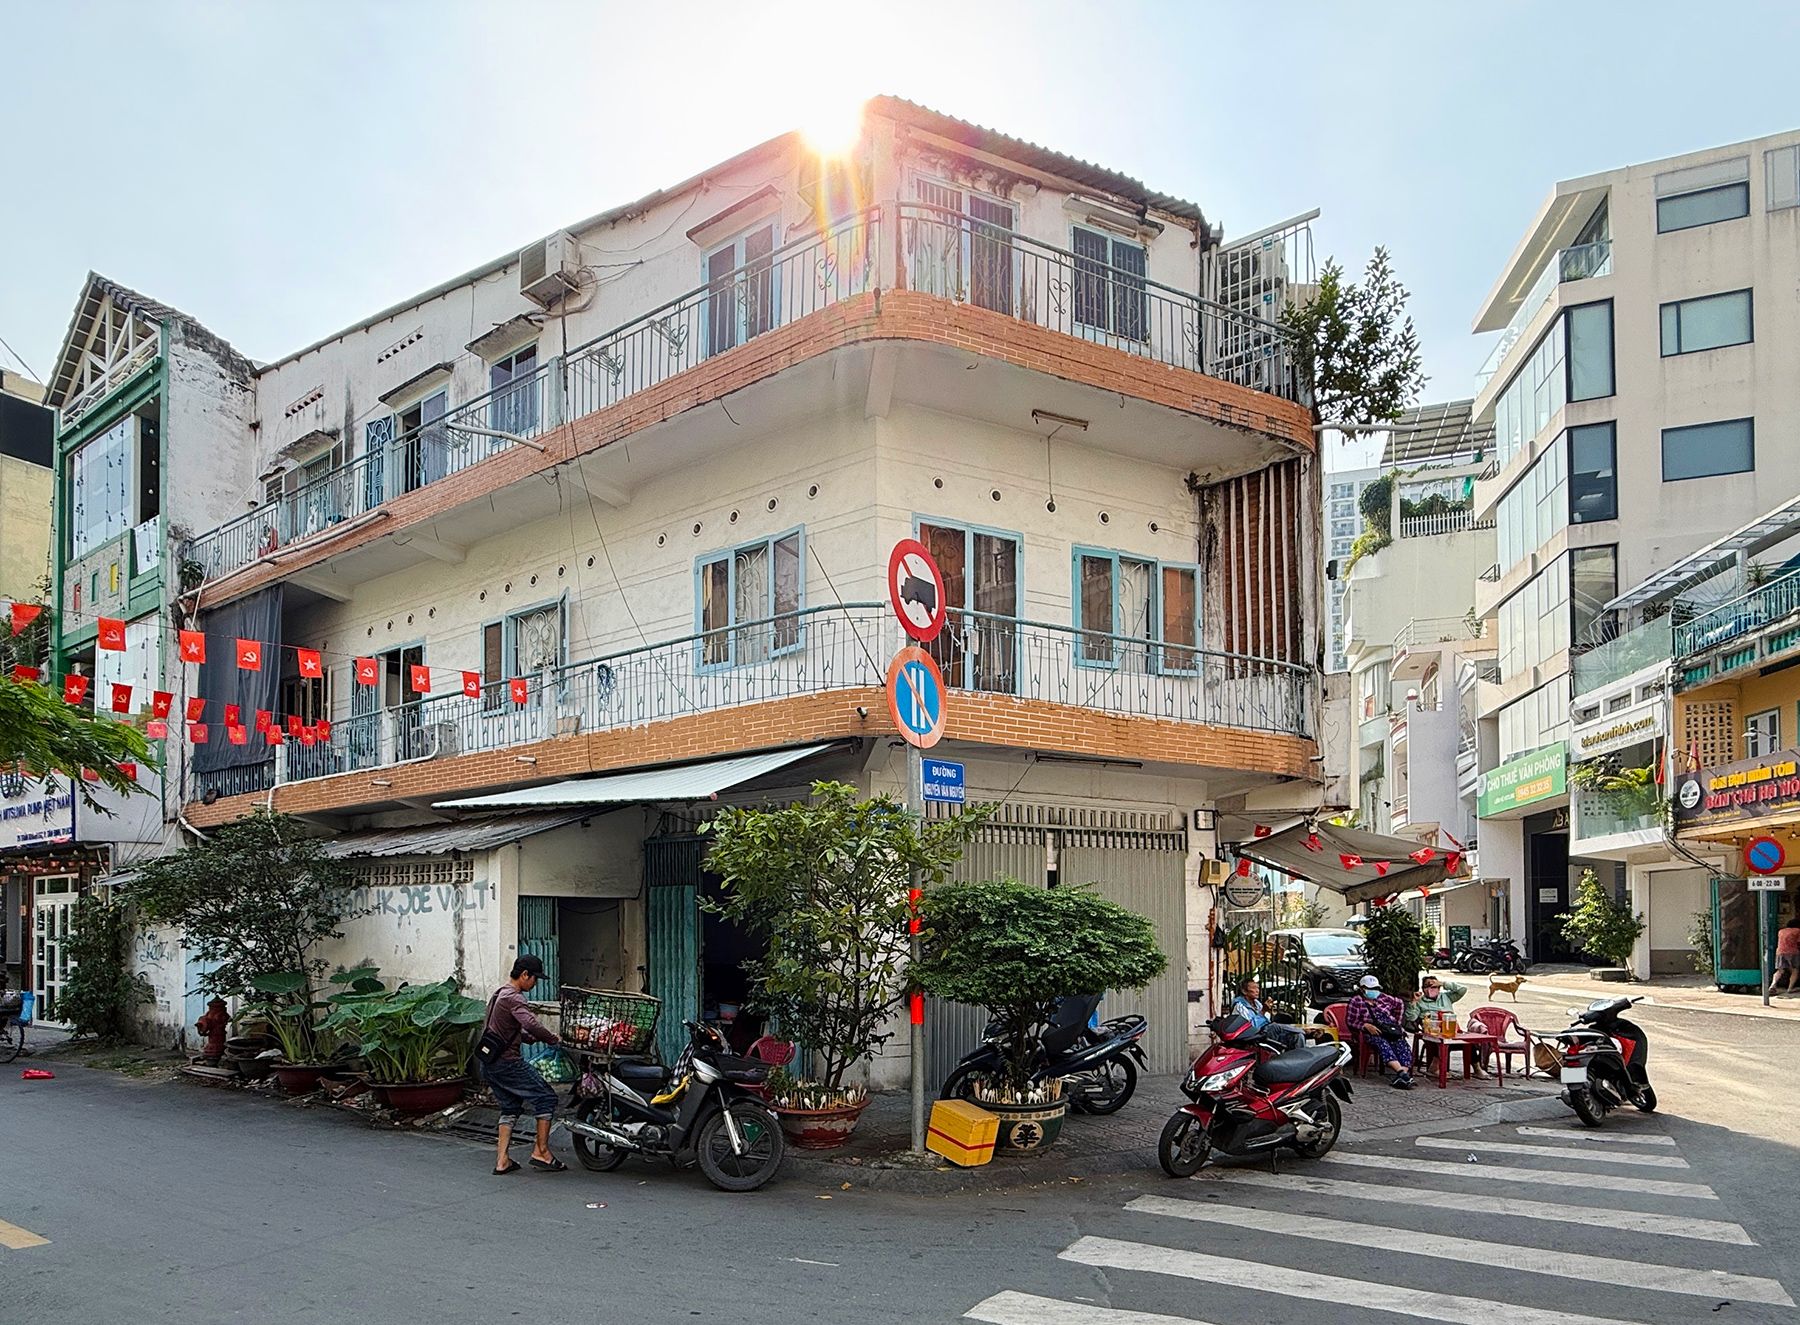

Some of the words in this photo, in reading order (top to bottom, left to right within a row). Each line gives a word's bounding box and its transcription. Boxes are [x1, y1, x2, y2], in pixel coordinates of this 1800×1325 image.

[932, 766, 957, 778] ĐƯỜNG
[398, 885, 432, 916] JOE
[436, 879, 489, 912] VOLT
